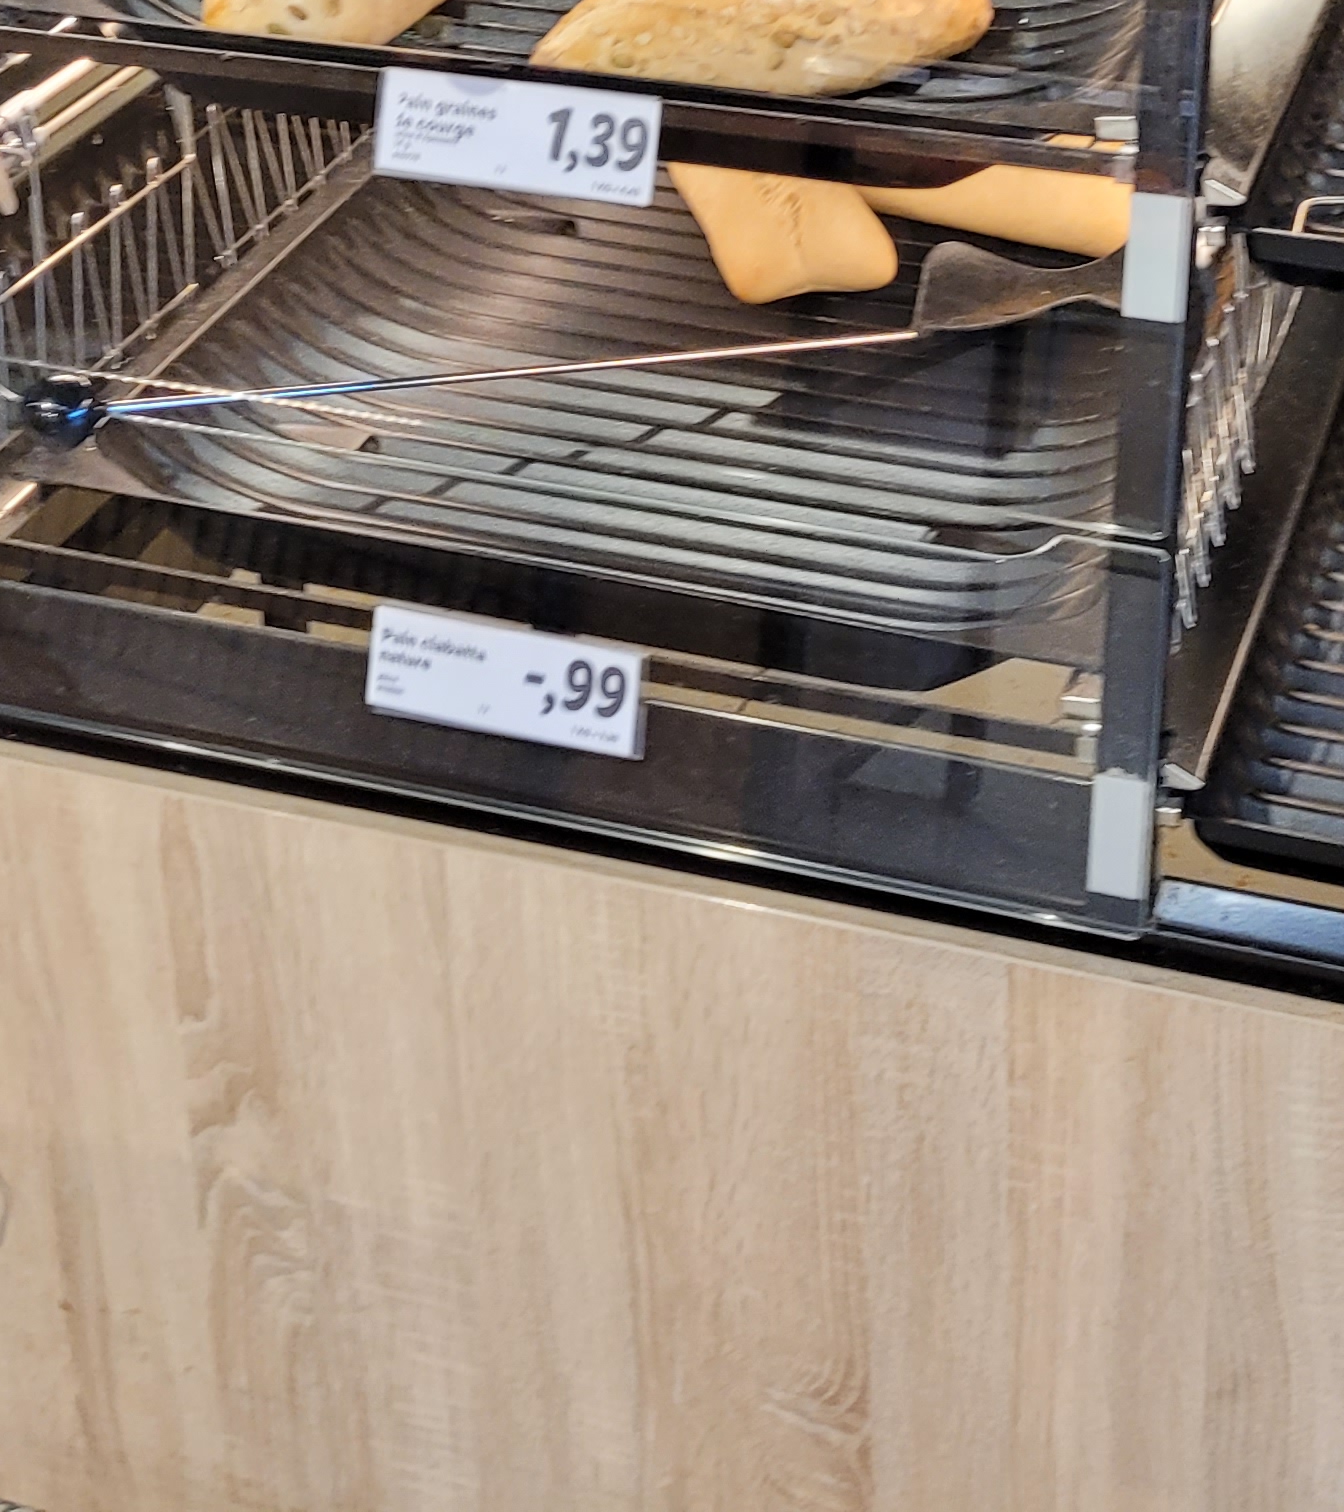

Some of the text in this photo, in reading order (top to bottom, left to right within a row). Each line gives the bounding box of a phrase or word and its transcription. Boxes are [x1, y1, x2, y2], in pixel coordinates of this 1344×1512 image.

[398, 91, 433, 111] Pain
[547, 106, 649, 173] 1,39
[381, 627, 417, 648] Pain
[524, 659, 626, 719] -,99
